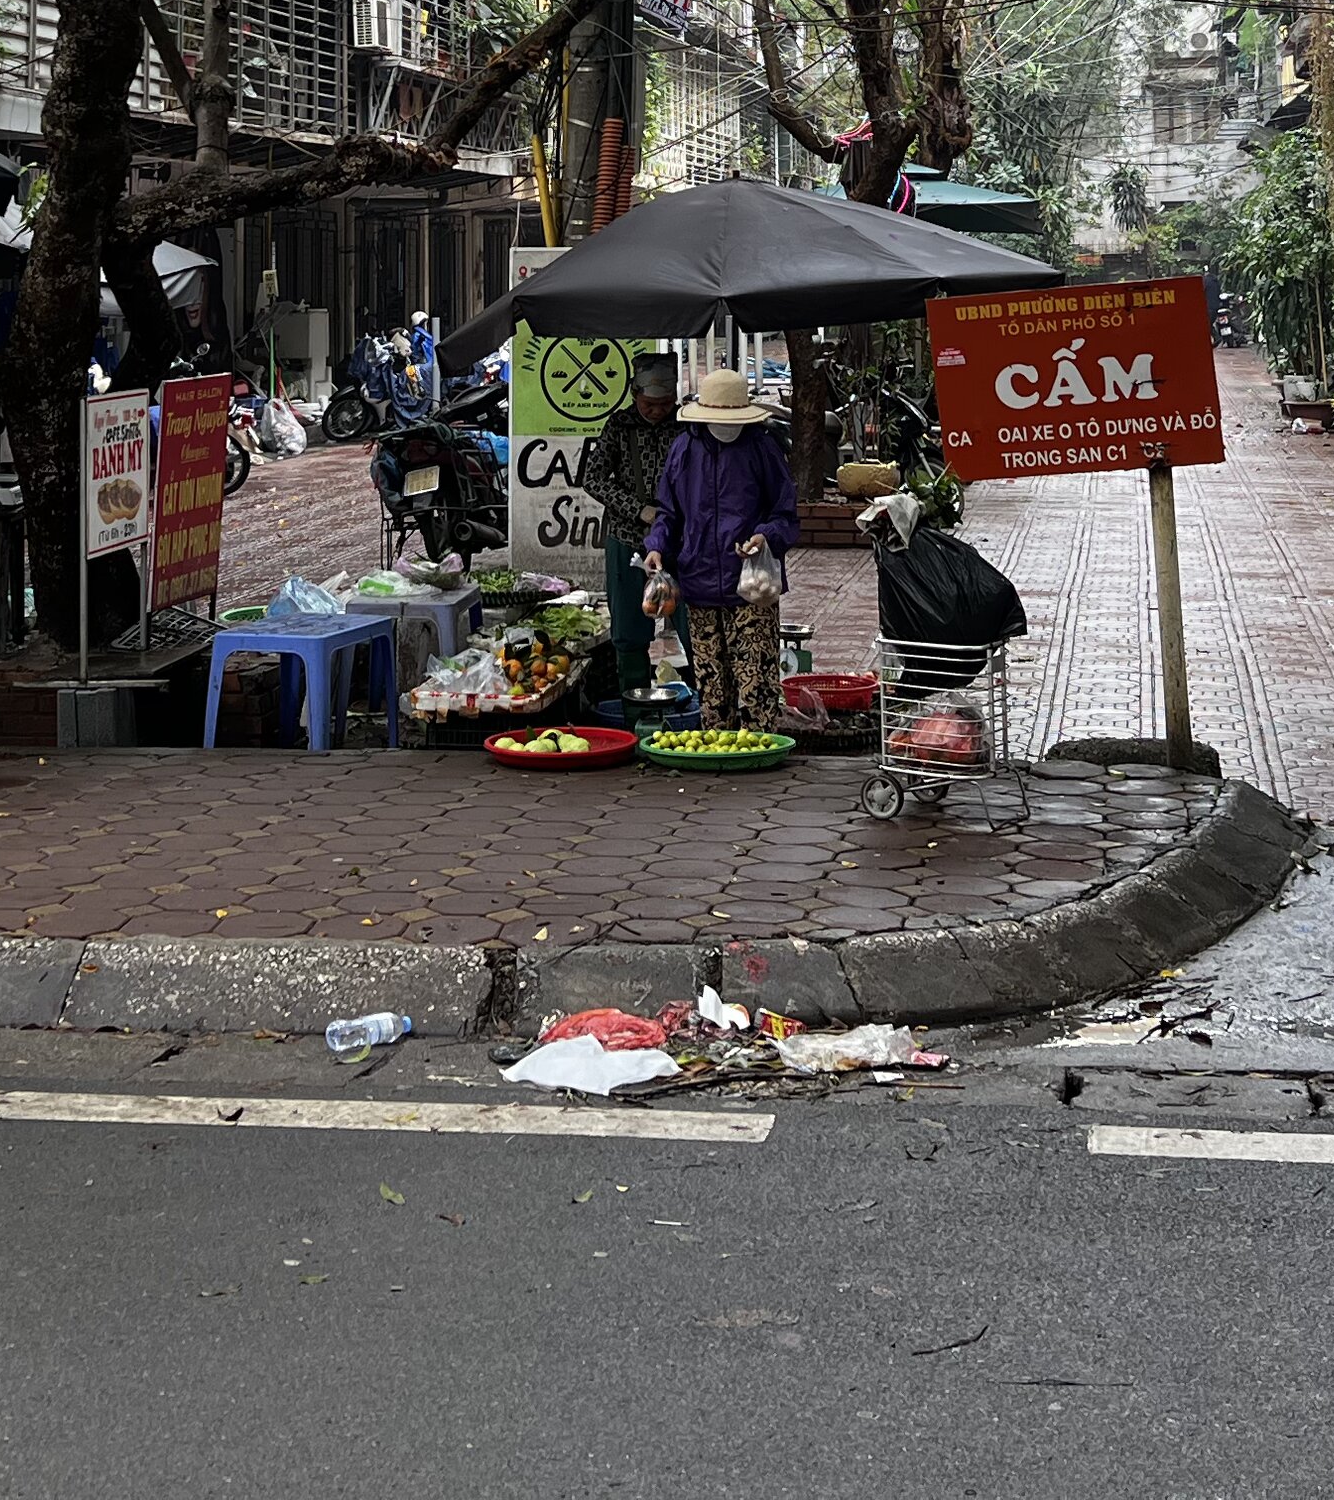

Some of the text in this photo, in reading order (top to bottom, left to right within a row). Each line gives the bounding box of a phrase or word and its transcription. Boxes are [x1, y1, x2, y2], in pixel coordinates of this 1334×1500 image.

[955, 303, 1003, 321] UBND
[1007, 293, 1078, 317] PHƯỜNG
[1131, 288, 1176, 307] BIÊN
[1024, 317, 1057, 334] DÂN
[1100, 309, 1123, 328] SỐ
[1128, 313, 1135, 325] 1
[994, 337, 1160, 410] CẤM
[175, 386, 223, 403] HAIR SALON
[166, 412, 193, 438] Trang
[948, 430, 973, 447] CA
[998, 426, 1028, 444] OAI
[1031, 424, 1055, 441] XE
[1058, 423, 1072, 439] O
[1076, 416, 1100, 438] TÔ
[1161, 410, 1187, 432] VÀ
[1190, 405, 1217, 430] ĐỖ
[1001, 449, 1062, 468] TRONG
[1066, 446, 1102, 464] SAN
[1106, 444, 1127, 461] C1
